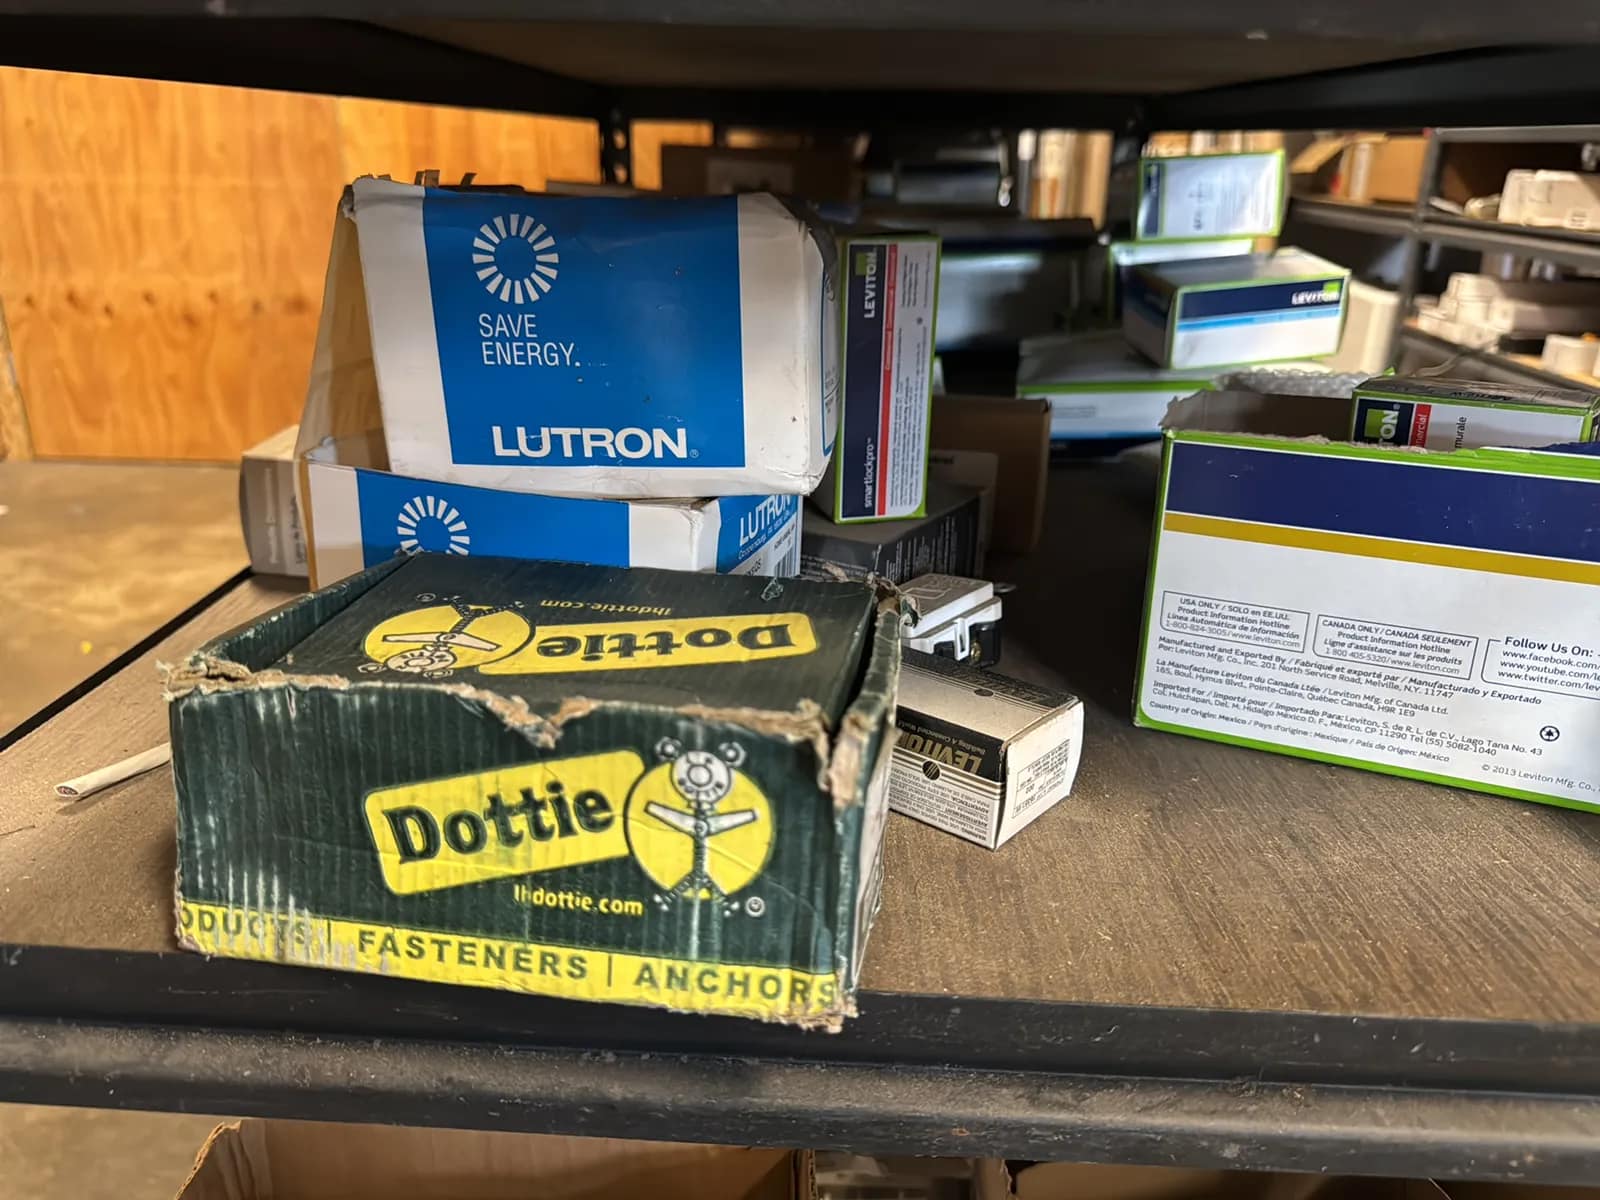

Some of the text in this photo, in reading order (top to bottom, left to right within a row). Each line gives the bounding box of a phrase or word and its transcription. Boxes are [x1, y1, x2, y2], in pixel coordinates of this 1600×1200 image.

[479, 313, 538, 338] SAVE
[1177, 606, 1289, 630] Product Information Hotline
[1180, 597, 1195, 606] USA
[1198, 600, 1219, 609] ONLY
[1228, 605, 1248, 614] SOLO
[1238, 623, 1248, 631] de
[1322, 618, 1355, 630] CANADA
[1421, 633, 1472, 648] SEULEMENT
[536, 622, 796, 662] Dottie
[1337, 630, 1450, 655] Product Information Hotline
[1504, 635, 1593, 658] Follow Us On:
[1159, 635, 1215, 651] Manufactured
[1217, 646, 1232, 654] and
[1234, 648, 1273, 661] Exported
[1275, 654, 1285, 664] By
[1383, 674, 1398, 682] par
[1408, 676, 1479, 695] Manufacturado
[1490, 690, 1541, 705] Exportado
[1175, 646, 1204, 657] Leviton
[1261, 661, 1275, 669] 201
[1278, 664, 1302, 673] North
[1305, 668, 1336, 679] Service
[1413, 651, 1424, 660] les
[1426, 655, 1461, 666] produits
[1156, 658, 1165, 666] La
[1167, 660, 1219, 675] Manufacture
[1221, 669, 1252, 681] Leviton
[1254, 675, 1264, 683] du
[1267, 677, 1298, 689] Canada
[1328, 687, 1360, 699] Leviton
[1395, 699, 1428, 711] Canada
[1153, 681, 1189, 693] Imported
[1191, 687, 1204, 696] For
[1247, 699, 1266, 707] pour
[1391, 722, 1403, 731] de
[1425, 728, 1437, 737] de
[1530, 746, 1542, 755] 43
[1364, 725, 1377, 734] CP
[1410, 733, 1423, 742] Tel
[1492, 765, 1516, 776] 2013
[1518, 770, 1552, 782] Leviton
[384, 781, 614, 864] Dottie
[358, 930, 588, 980] FASTENERS
